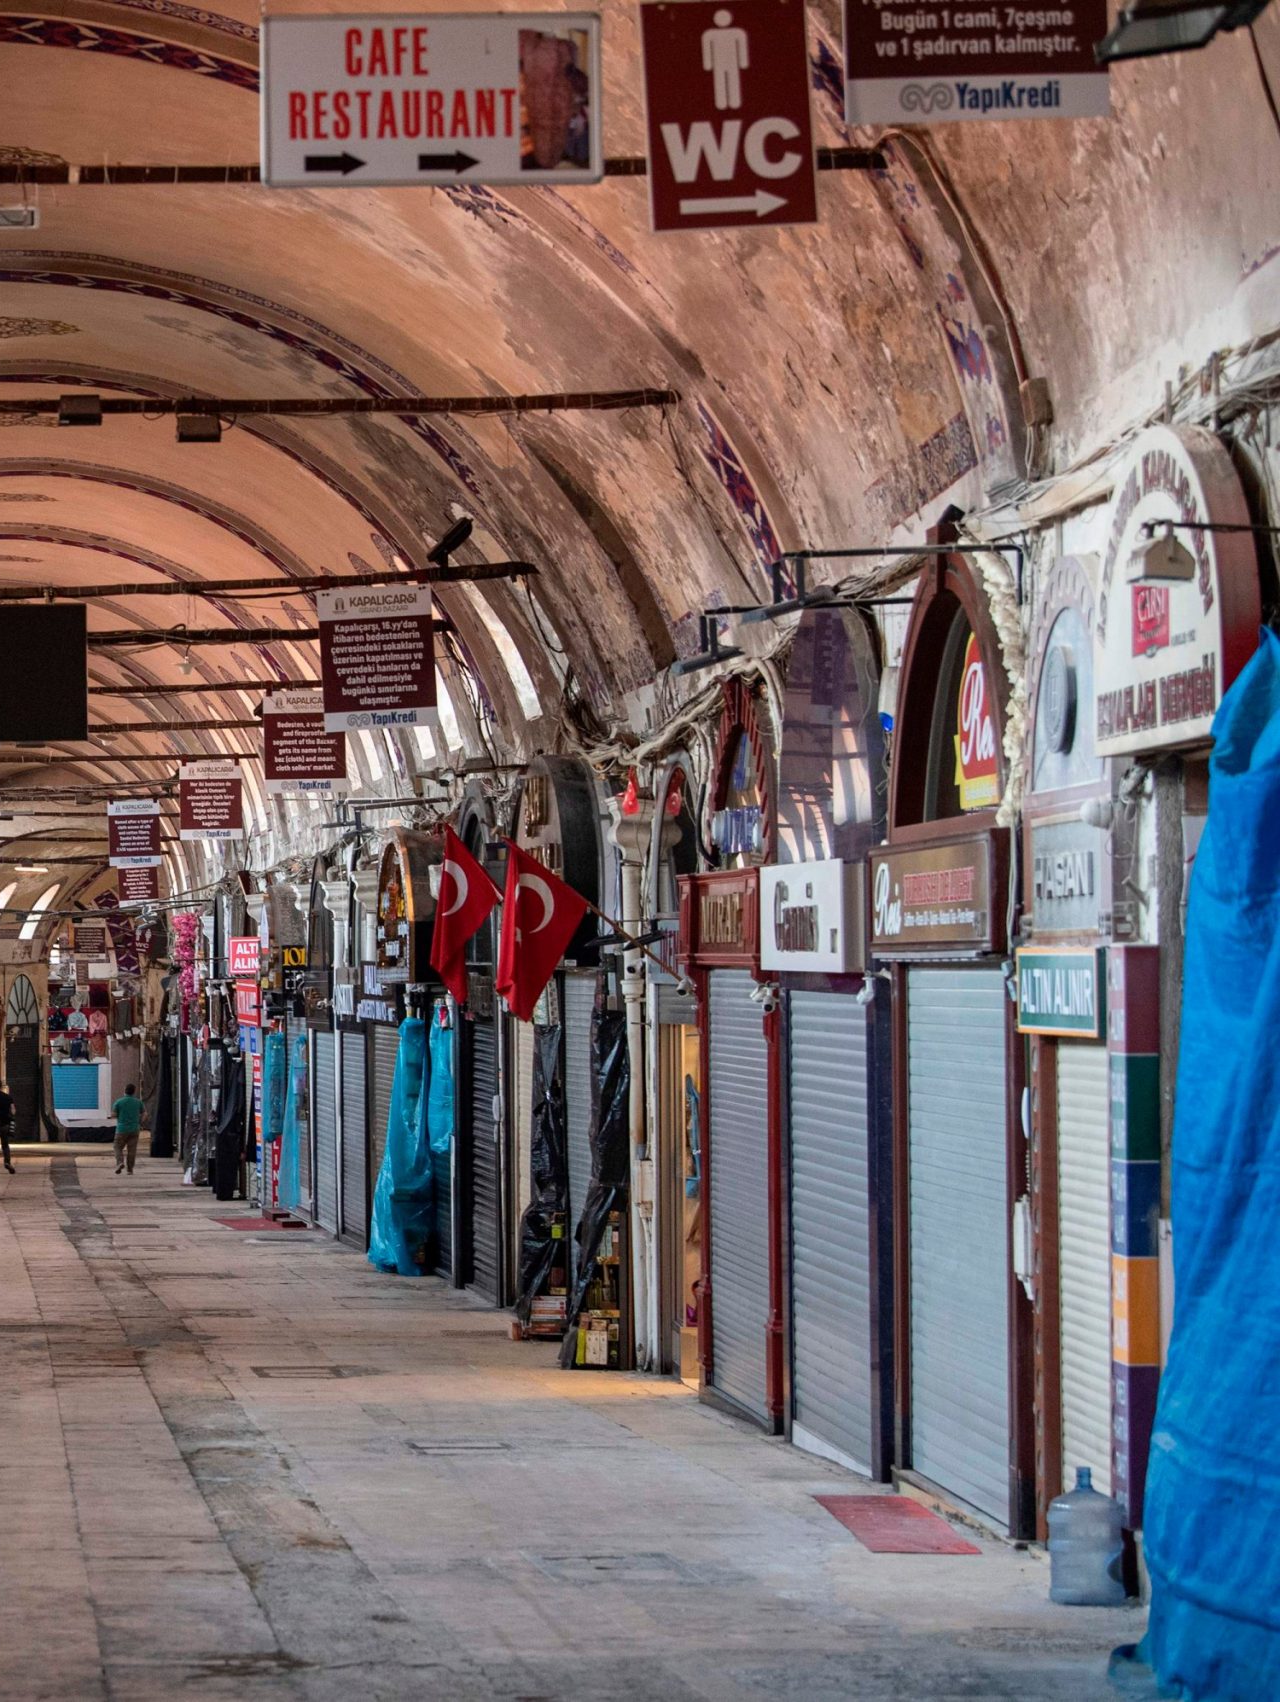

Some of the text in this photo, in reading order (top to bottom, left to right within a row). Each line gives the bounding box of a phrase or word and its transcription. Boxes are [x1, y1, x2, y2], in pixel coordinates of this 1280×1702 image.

[881, 11, 937, 34] Bugün
[943, 11, 949, 28] 1
[954, 11, 1001, 30] cami,
[345, 28, 429, 77] CAFE
[876, 35, 1080, 60] ve 1 şadırvan kalmıştır.
[956, 81, 1060, 112] YapıKredi
[289, 89, 517, 140] RESTAURANT
[660, 116, 803, 184] WC
[335, 624, 380, 633] Kapalıçarşı,
[333, 631, 420, 643] itibaren bedestenlerin
[331, 642, 424, 655] çevresindeki sokakların
[333, 654, 364, 665] üzerinin
[366, 653, 411, 663] kapatılması
[337, 662, 421, 677] çevredeki hanların da
[347, 673, 412, 685] dahil edilmesiyle
[342, 684, 418, 697] bugünkü sınırlarına
[360, 695, 402, 707] ulaşmıştır.
[371, 712, 417, 726] YapıKredi
[236, 943, 259, 955] ALTI
[234, 956, 260, 969] ALIN
[283, 948, 306, 966] 101
[1021, 969, 1052, 1014] ALTIN
[1054, 969, 1093, 1016] ALINIR
